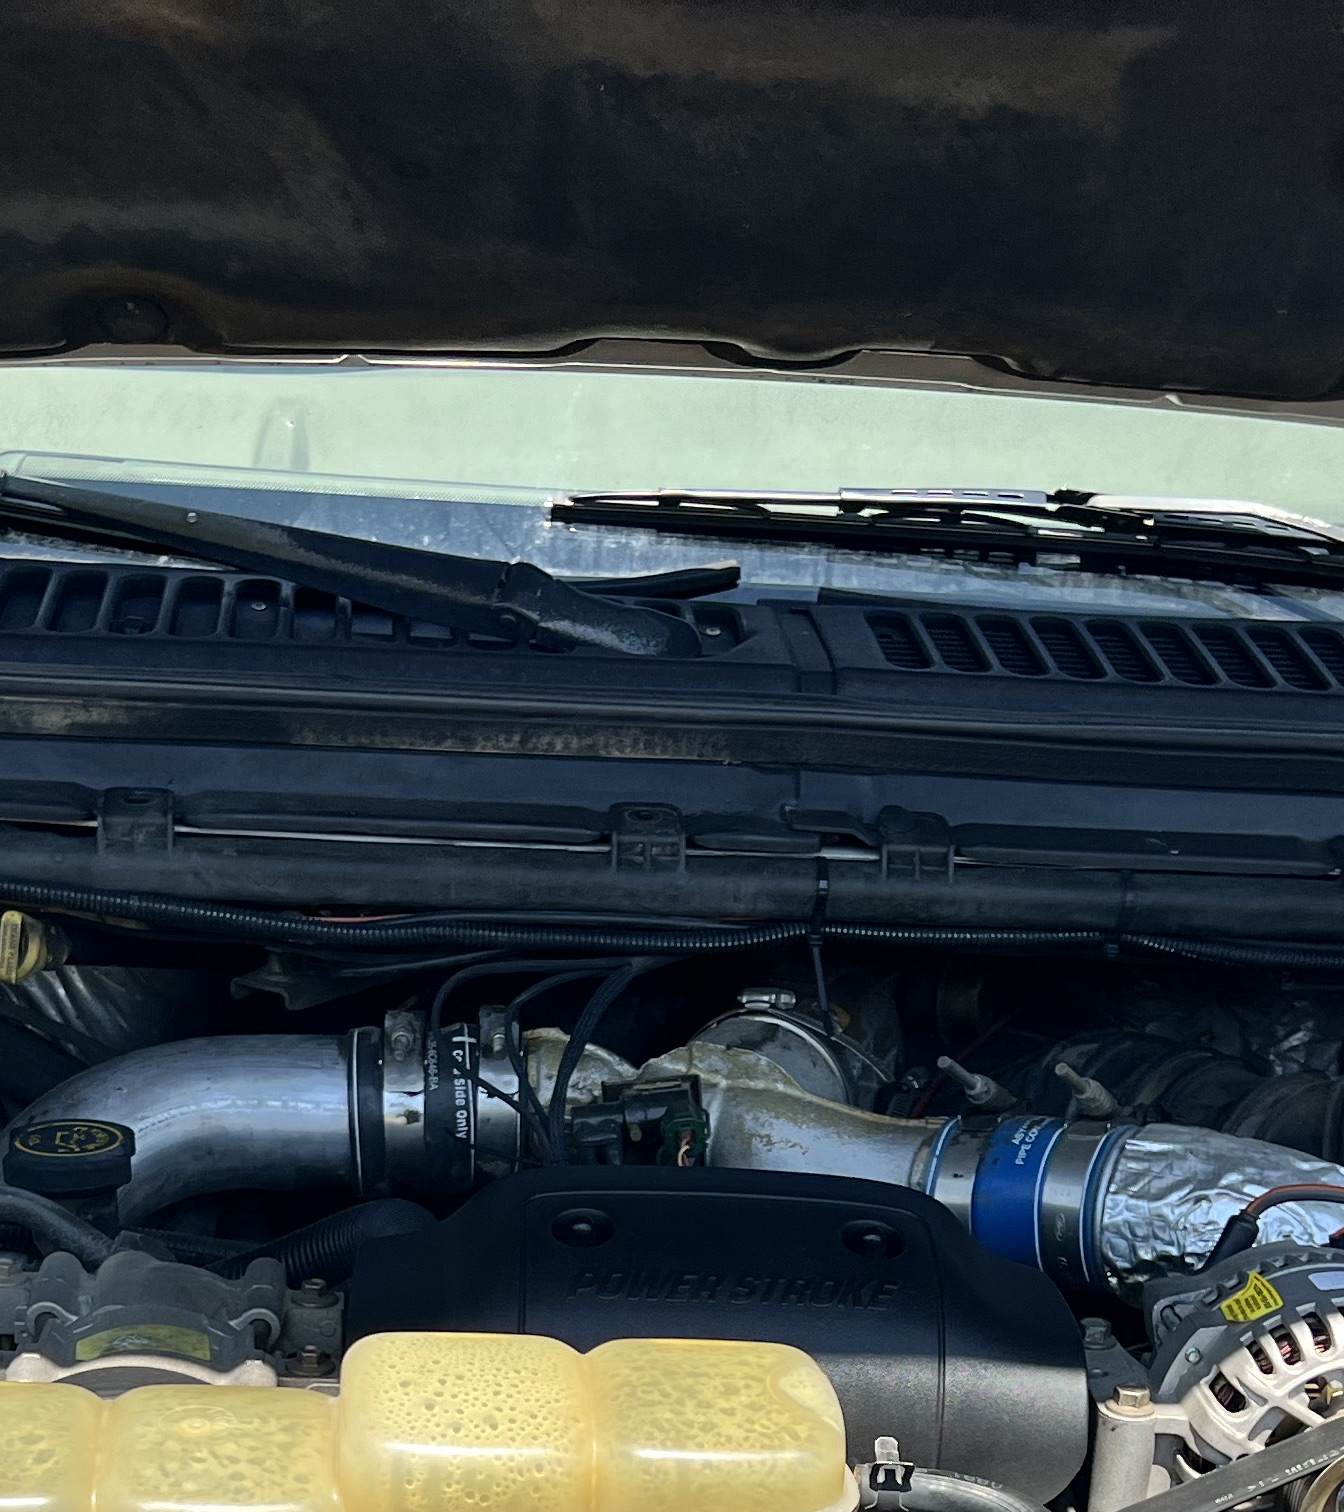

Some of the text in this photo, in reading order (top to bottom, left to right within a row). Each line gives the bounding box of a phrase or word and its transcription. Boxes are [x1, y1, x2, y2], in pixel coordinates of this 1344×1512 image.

[456, 1109, 469, 1139] Only
[1014, 1143, 1032, 1165] PIPE
[566, 1268, 900, 1312] POWER STROKE
